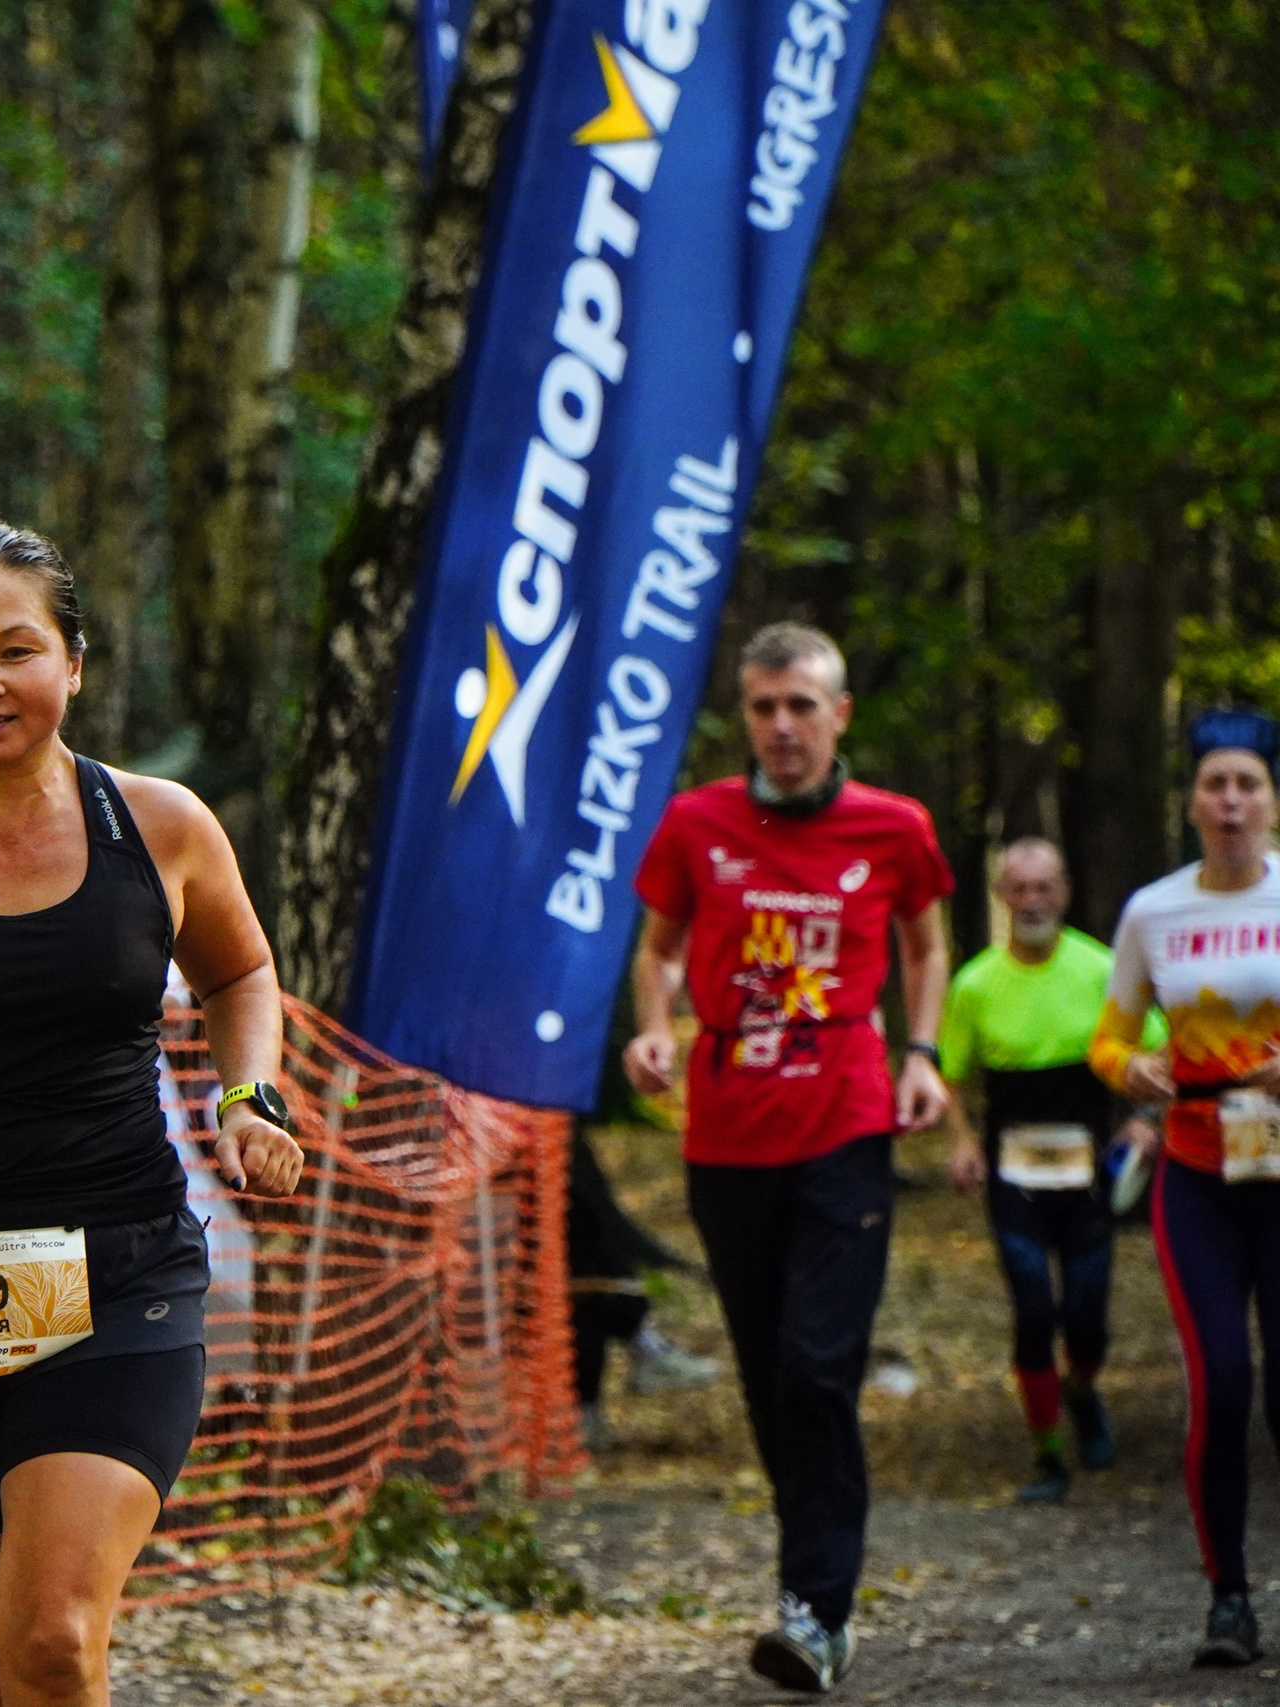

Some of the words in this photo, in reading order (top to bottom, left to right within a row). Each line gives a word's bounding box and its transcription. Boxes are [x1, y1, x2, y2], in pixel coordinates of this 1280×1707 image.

[545, 653, 672, 933] BLIZKO
[622, 433, 739, 643] TRAIL
[101, 799, 123, 840] Reebok
[31, 1240, 66, 1249] Moscow
[10, 1345, 36, 1355] PRO
